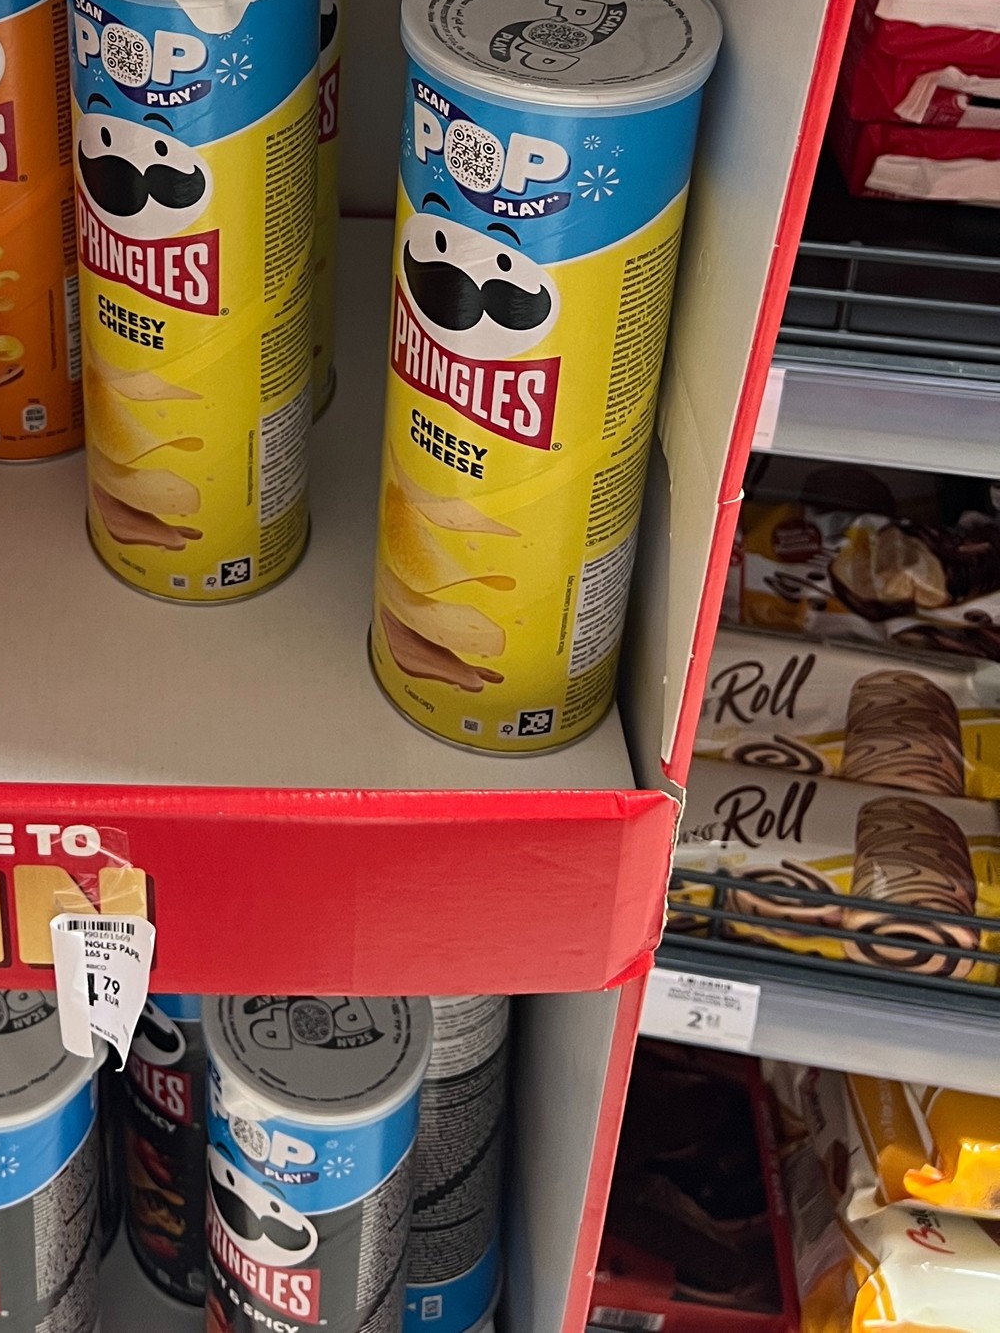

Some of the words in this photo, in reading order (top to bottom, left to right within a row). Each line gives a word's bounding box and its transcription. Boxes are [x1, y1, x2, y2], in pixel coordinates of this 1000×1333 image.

[595, 5, 623, 36] SCAN
[417, 83, 450, 116] SCAN
[78, 203, 209, 306] PRINGLES
[98, 293, 166, 334] CHEESY
[98, 309, 164, 350] CHEESE
[393, 295, 547, 438] PRINGLES
[410, 426, 484, 480] CHEESE
[411, 408, 488, 462] CHEESY
[711, 653, 816, 724] Roll
[714, 780, 818, 849] Roll
[26, 824, 102, 856] TO
[85, 940, 117, 951] NGLES
[85, 950, 101, 958] 165
[103, 975, 121, 995] 79
[104, 993, 120, 1008] EUR
[687, 1010, 703, 1030] 2
